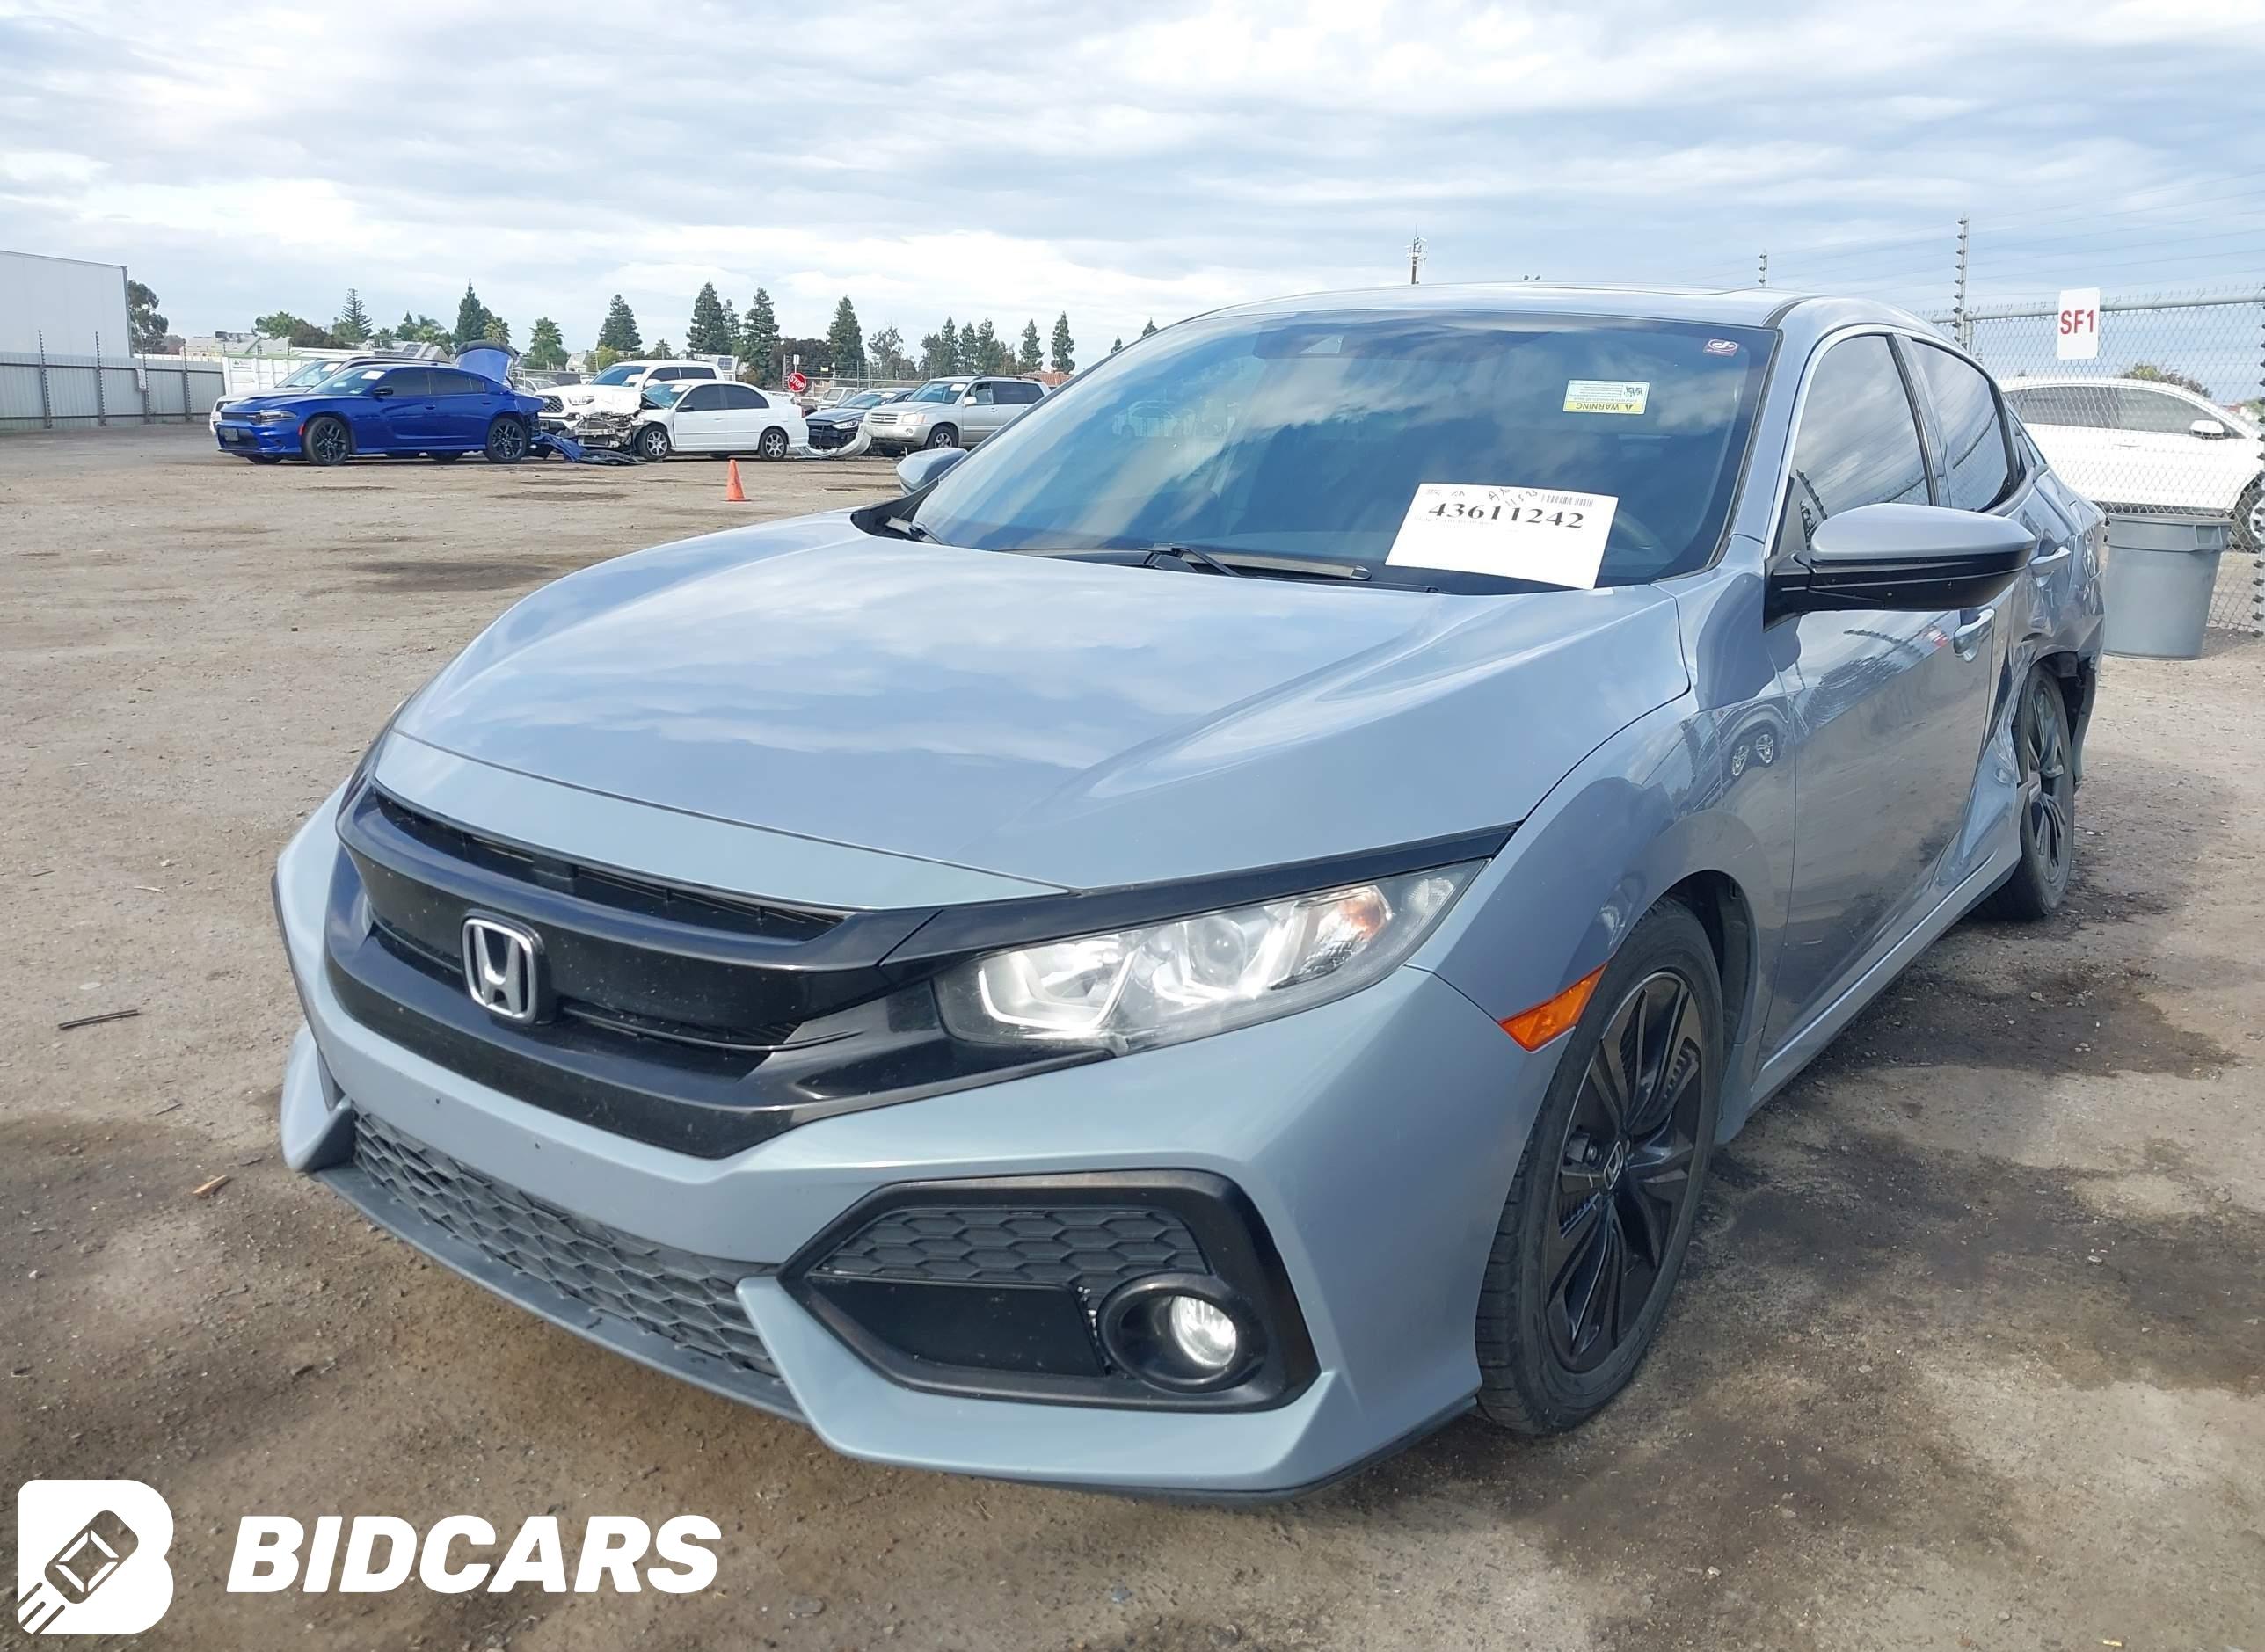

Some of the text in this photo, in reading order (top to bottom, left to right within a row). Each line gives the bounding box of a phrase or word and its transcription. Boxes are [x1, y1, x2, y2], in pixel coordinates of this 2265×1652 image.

[2060, 309, 2094, 335] SF1
[789, 375, 805, 389] STOP
[1576, 402, 1620, 411] WARNING
[1428, 502, 1584, 529] 43611242
